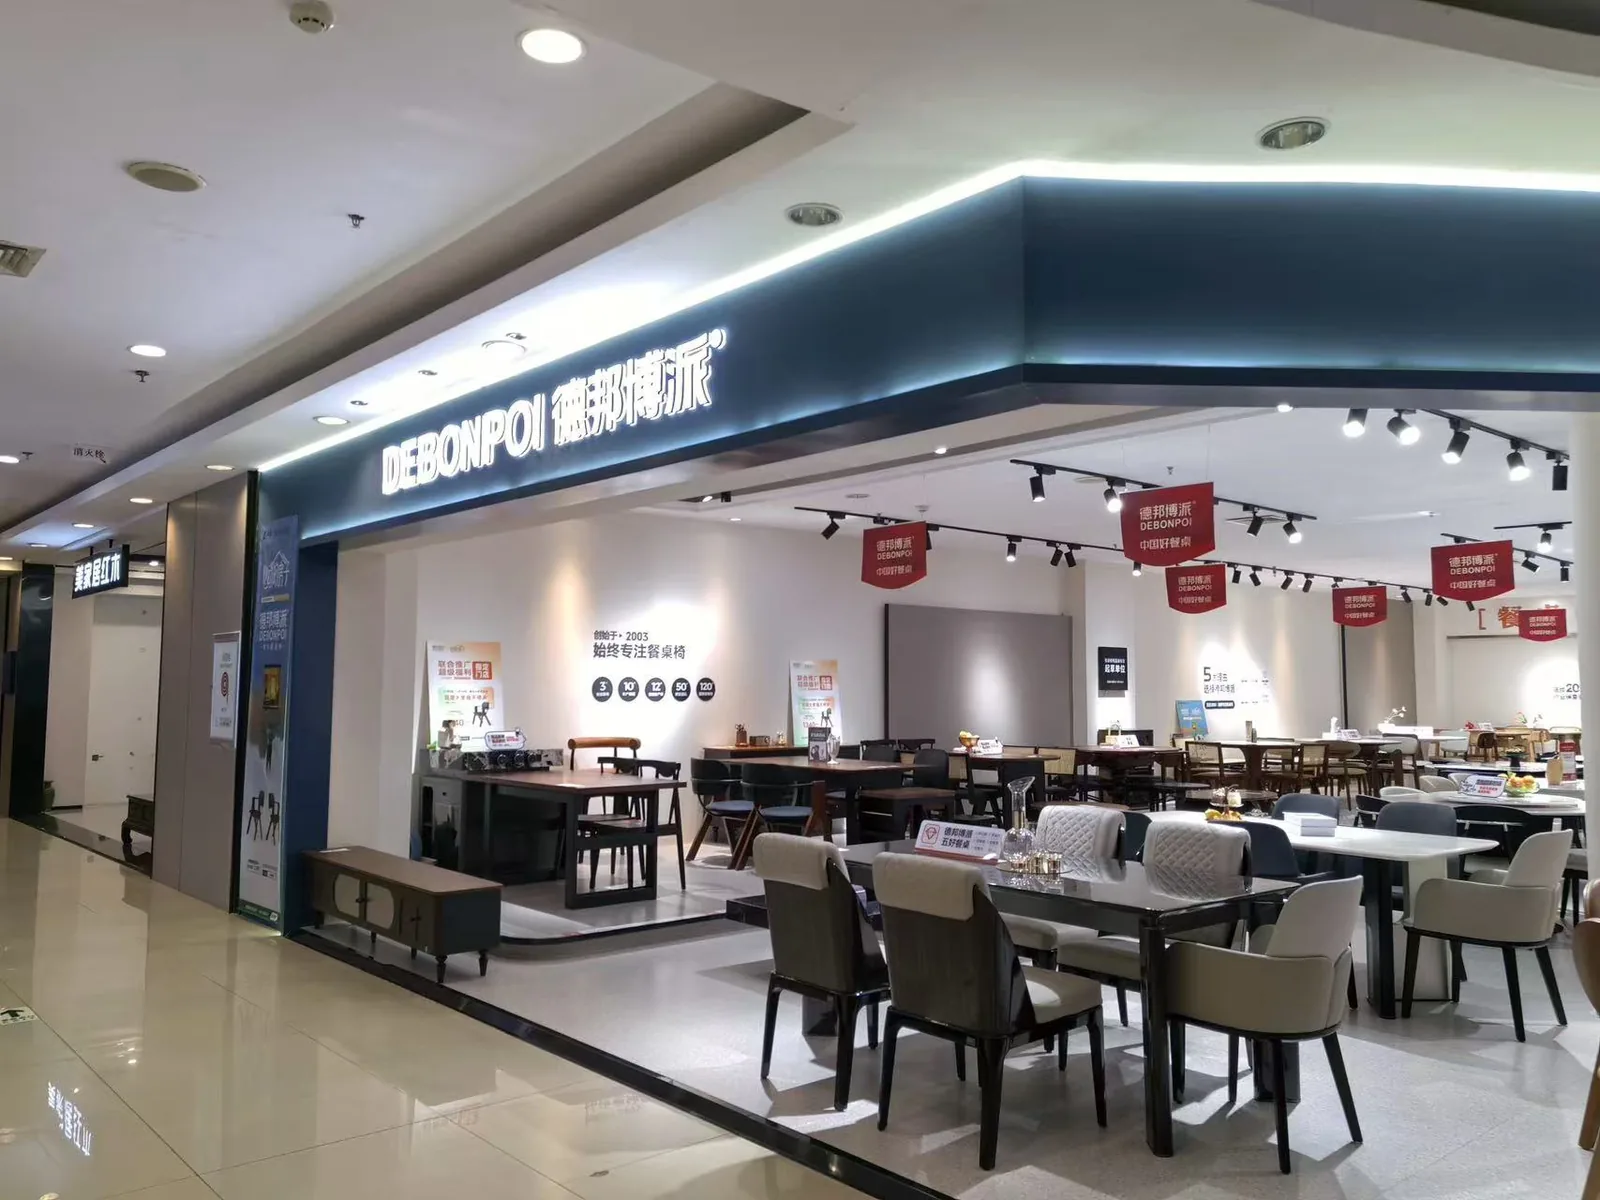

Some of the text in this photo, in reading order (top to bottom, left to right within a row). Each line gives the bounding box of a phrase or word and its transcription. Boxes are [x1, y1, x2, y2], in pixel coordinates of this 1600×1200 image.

[381, 332, 713, 495] DEBONPOI 德邦博派
[1139, 502, 1192, 521] 德邦博派
[1140, 517, 1192, 531] DEBONPOI
[877, 549, 913, 560] DEBONPOI
[1449, 554, 1495, 567] 德邦博派
[74, 553, 121, 592] 美家居红木
[1450, 565, 1496, 575] DEBONPOI
[626, 632, 649, 641] 2003
[593, 642, 686, 660] 始终专注餐桌椅
[943, 827, 973, 838] 德邦博派
[940, 837, 970, 849] 五好餐桌
